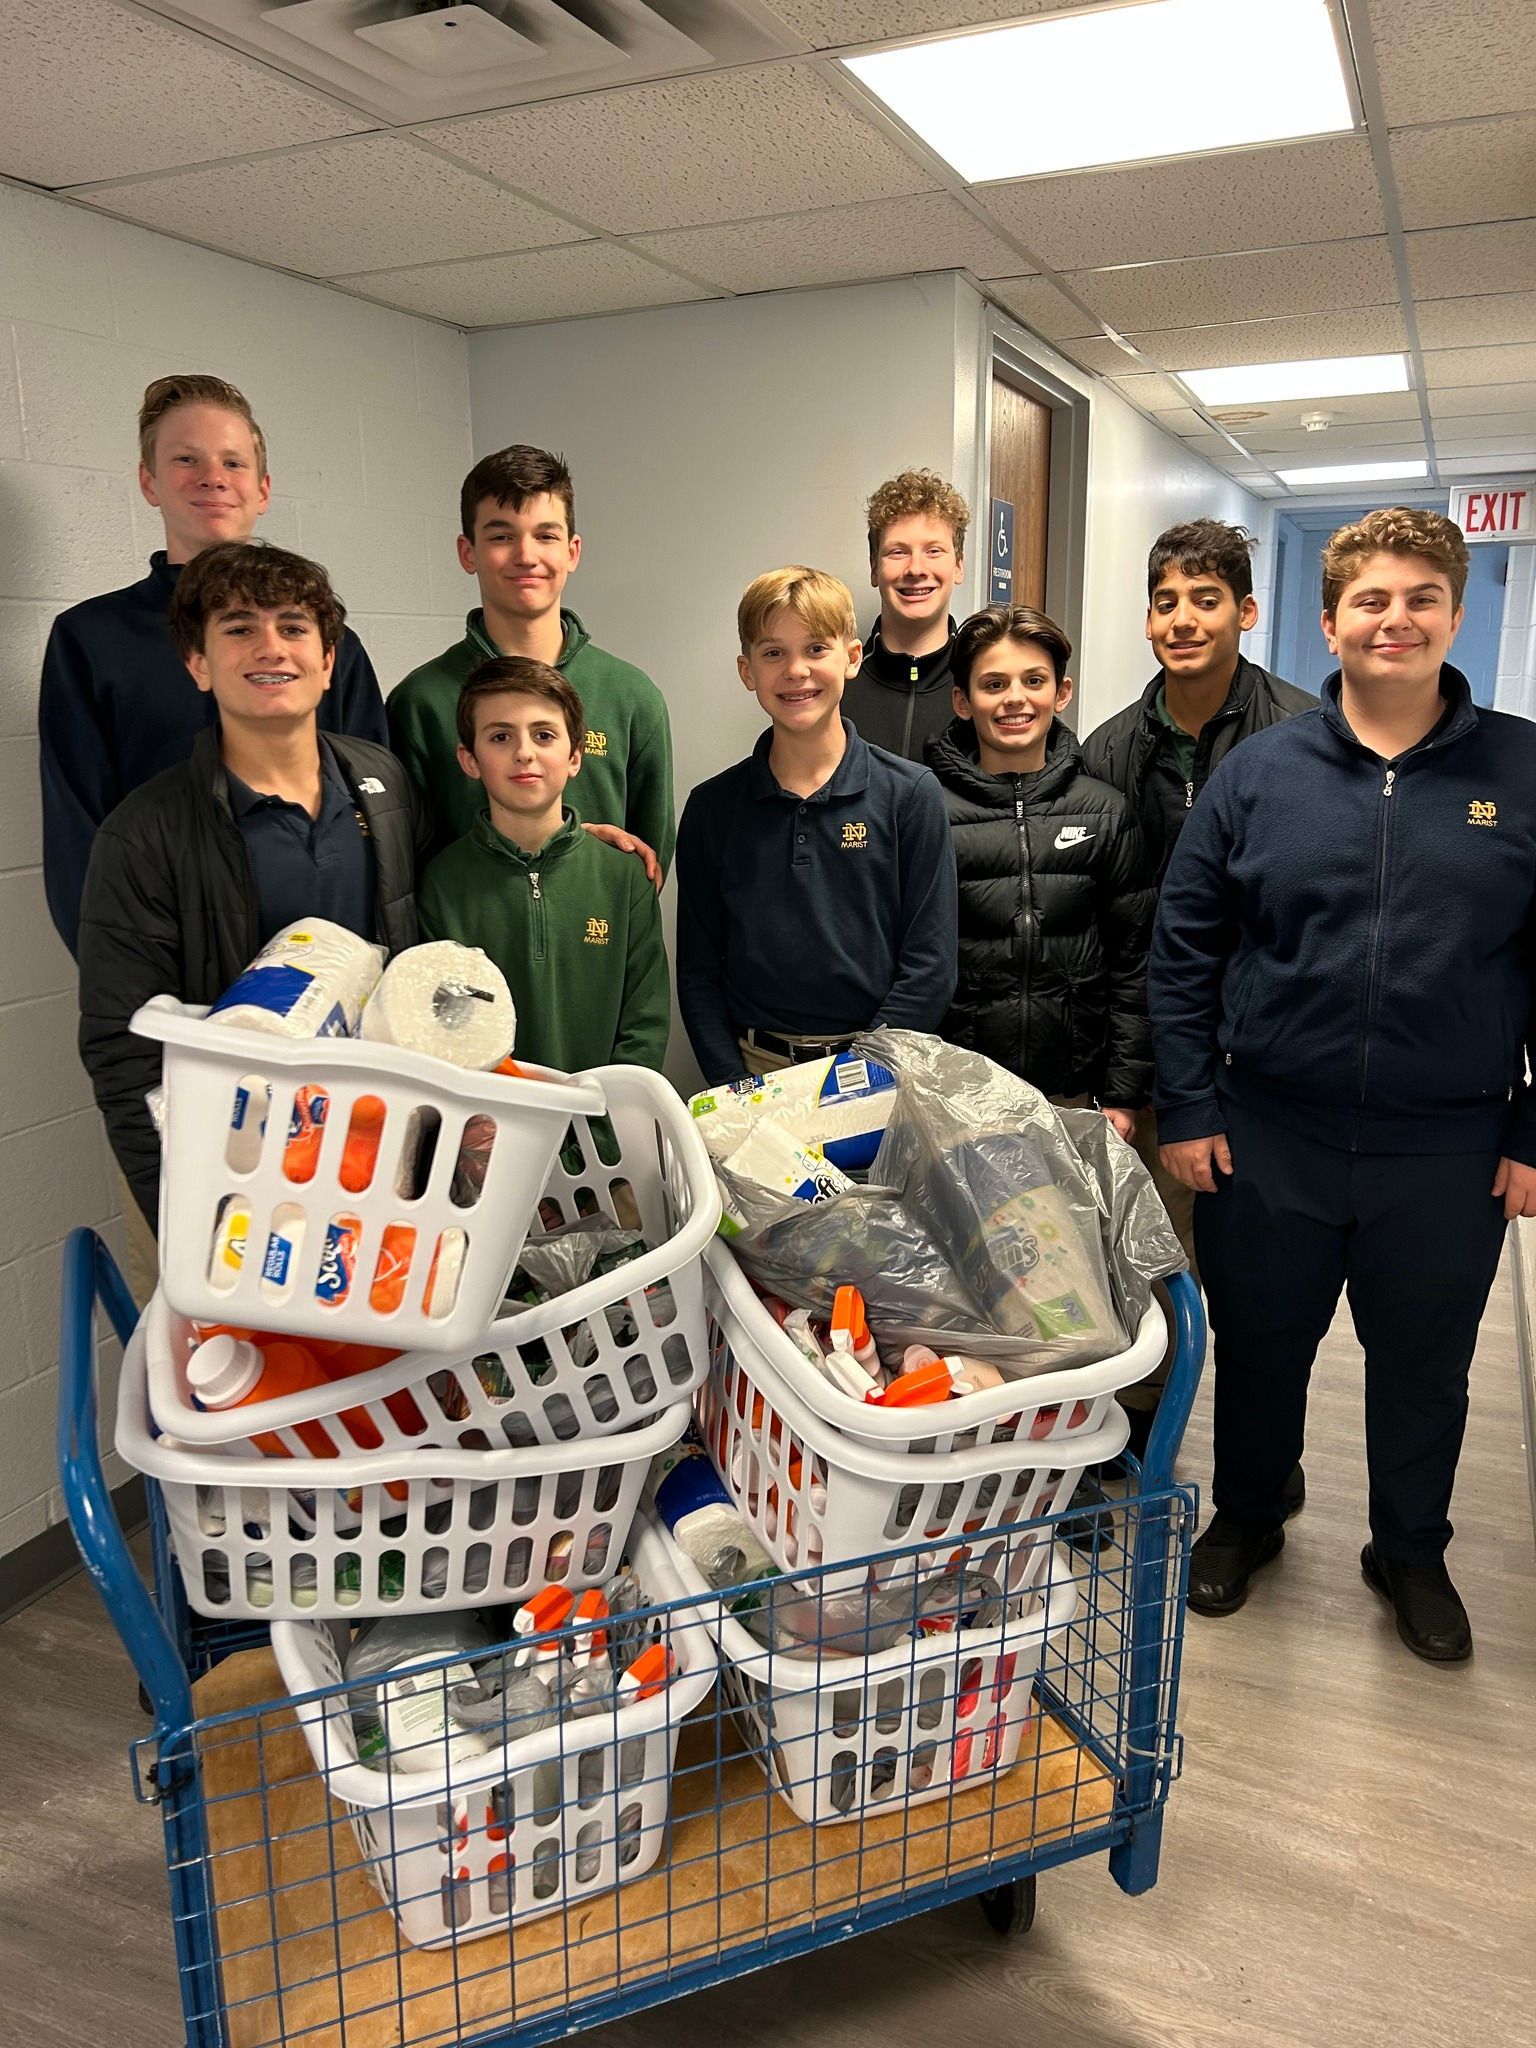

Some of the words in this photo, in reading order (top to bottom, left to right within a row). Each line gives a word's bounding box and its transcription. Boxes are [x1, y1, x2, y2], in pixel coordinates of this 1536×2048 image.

[1466, 491, 1526, 532] EXIT
[1060, 826, 1087, 840] NIKE
[1467, 818, 1498, 827] MARIST
[583, 936, 610, 945] MARIST
[264, 1235, 280, 1278] REGULAR
[271, 1250, 286, 1279] ROLLS
